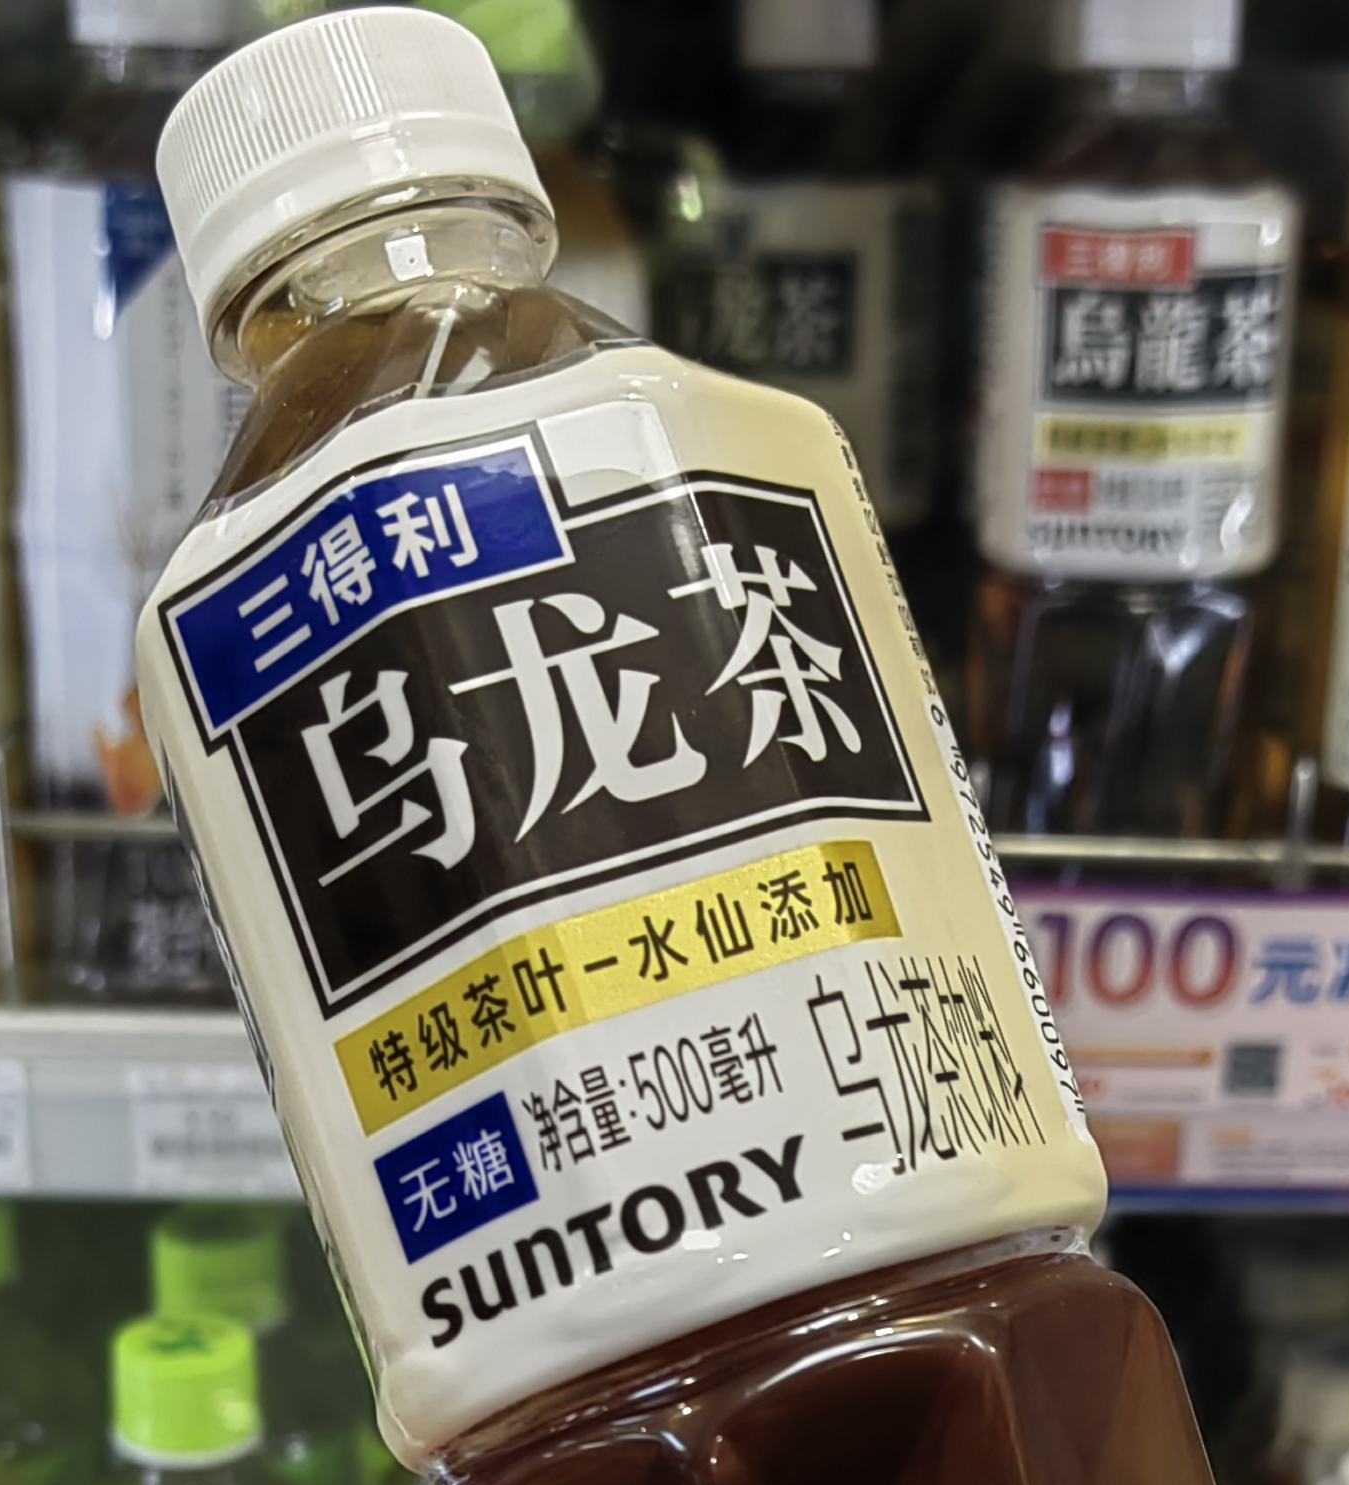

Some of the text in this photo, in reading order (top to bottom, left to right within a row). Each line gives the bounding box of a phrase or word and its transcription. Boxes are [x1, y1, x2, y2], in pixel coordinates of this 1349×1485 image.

[237, 482, 480, 674] 三得利
[300, 542, 863, 888] 乌龙茶
[806, 954, 1048, 1177] 乌龙茶饮料
[398, 1129, 516, 1233] 无糖
[420, 1134, 806, 1349] SUNTORY
